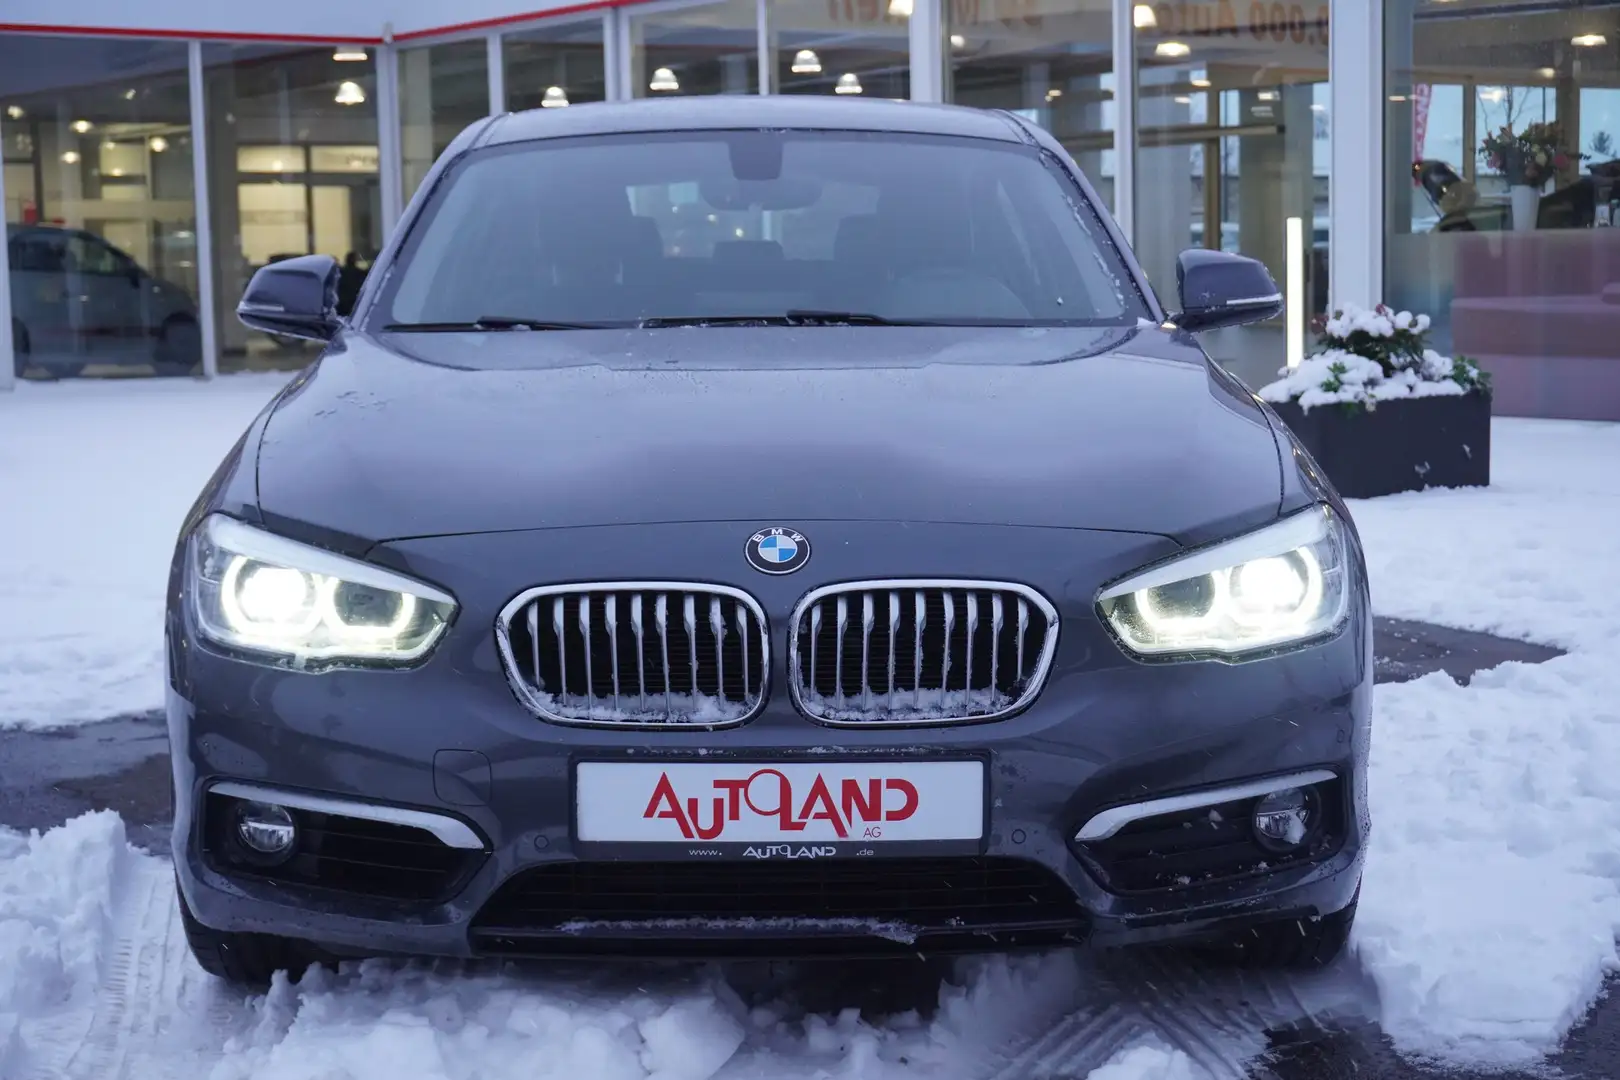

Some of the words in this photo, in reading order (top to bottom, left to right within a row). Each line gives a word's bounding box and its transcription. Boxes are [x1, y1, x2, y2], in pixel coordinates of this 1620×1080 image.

[752, 528, 804, 543] BMW
[643, 768, 919, 840] AUTOLAND
[862, 826, 882, 838] AG
[742, 844, 837, 859] AUTOLAND
[855, 848, 874, 857] .de
